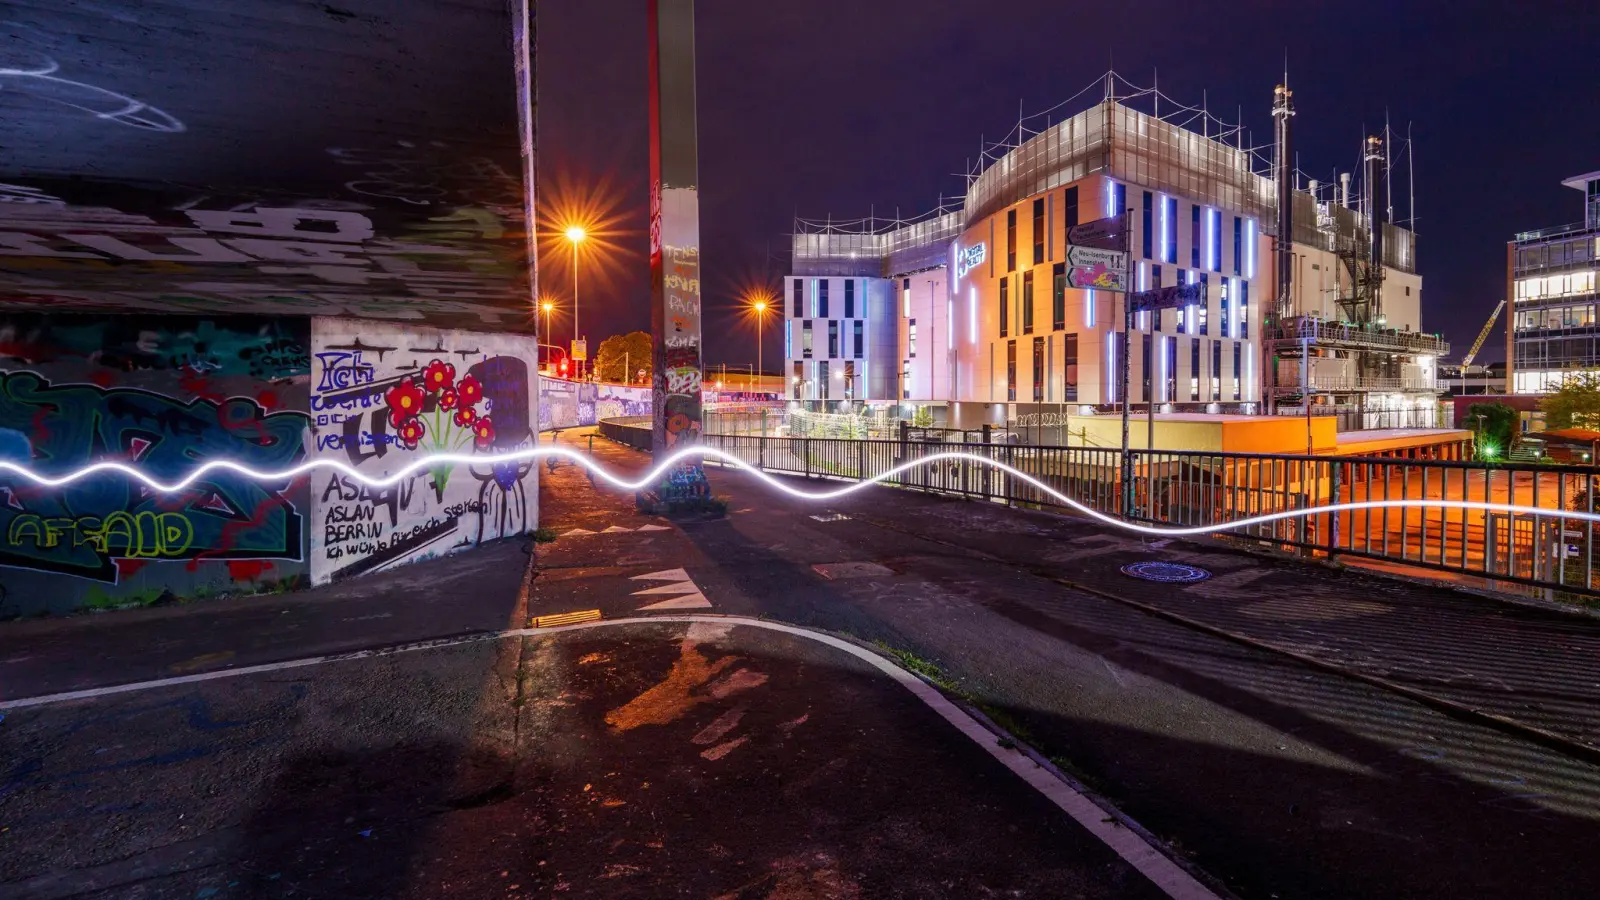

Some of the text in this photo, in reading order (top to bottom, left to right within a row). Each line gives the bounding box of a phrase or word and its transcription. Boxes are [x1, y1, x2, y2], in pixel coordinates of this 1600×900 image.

[325, 504, 375, 525] ASLAN
[8, 511, 194, 558] AFRAID
[324, 522, 383, 547] BERRIN
